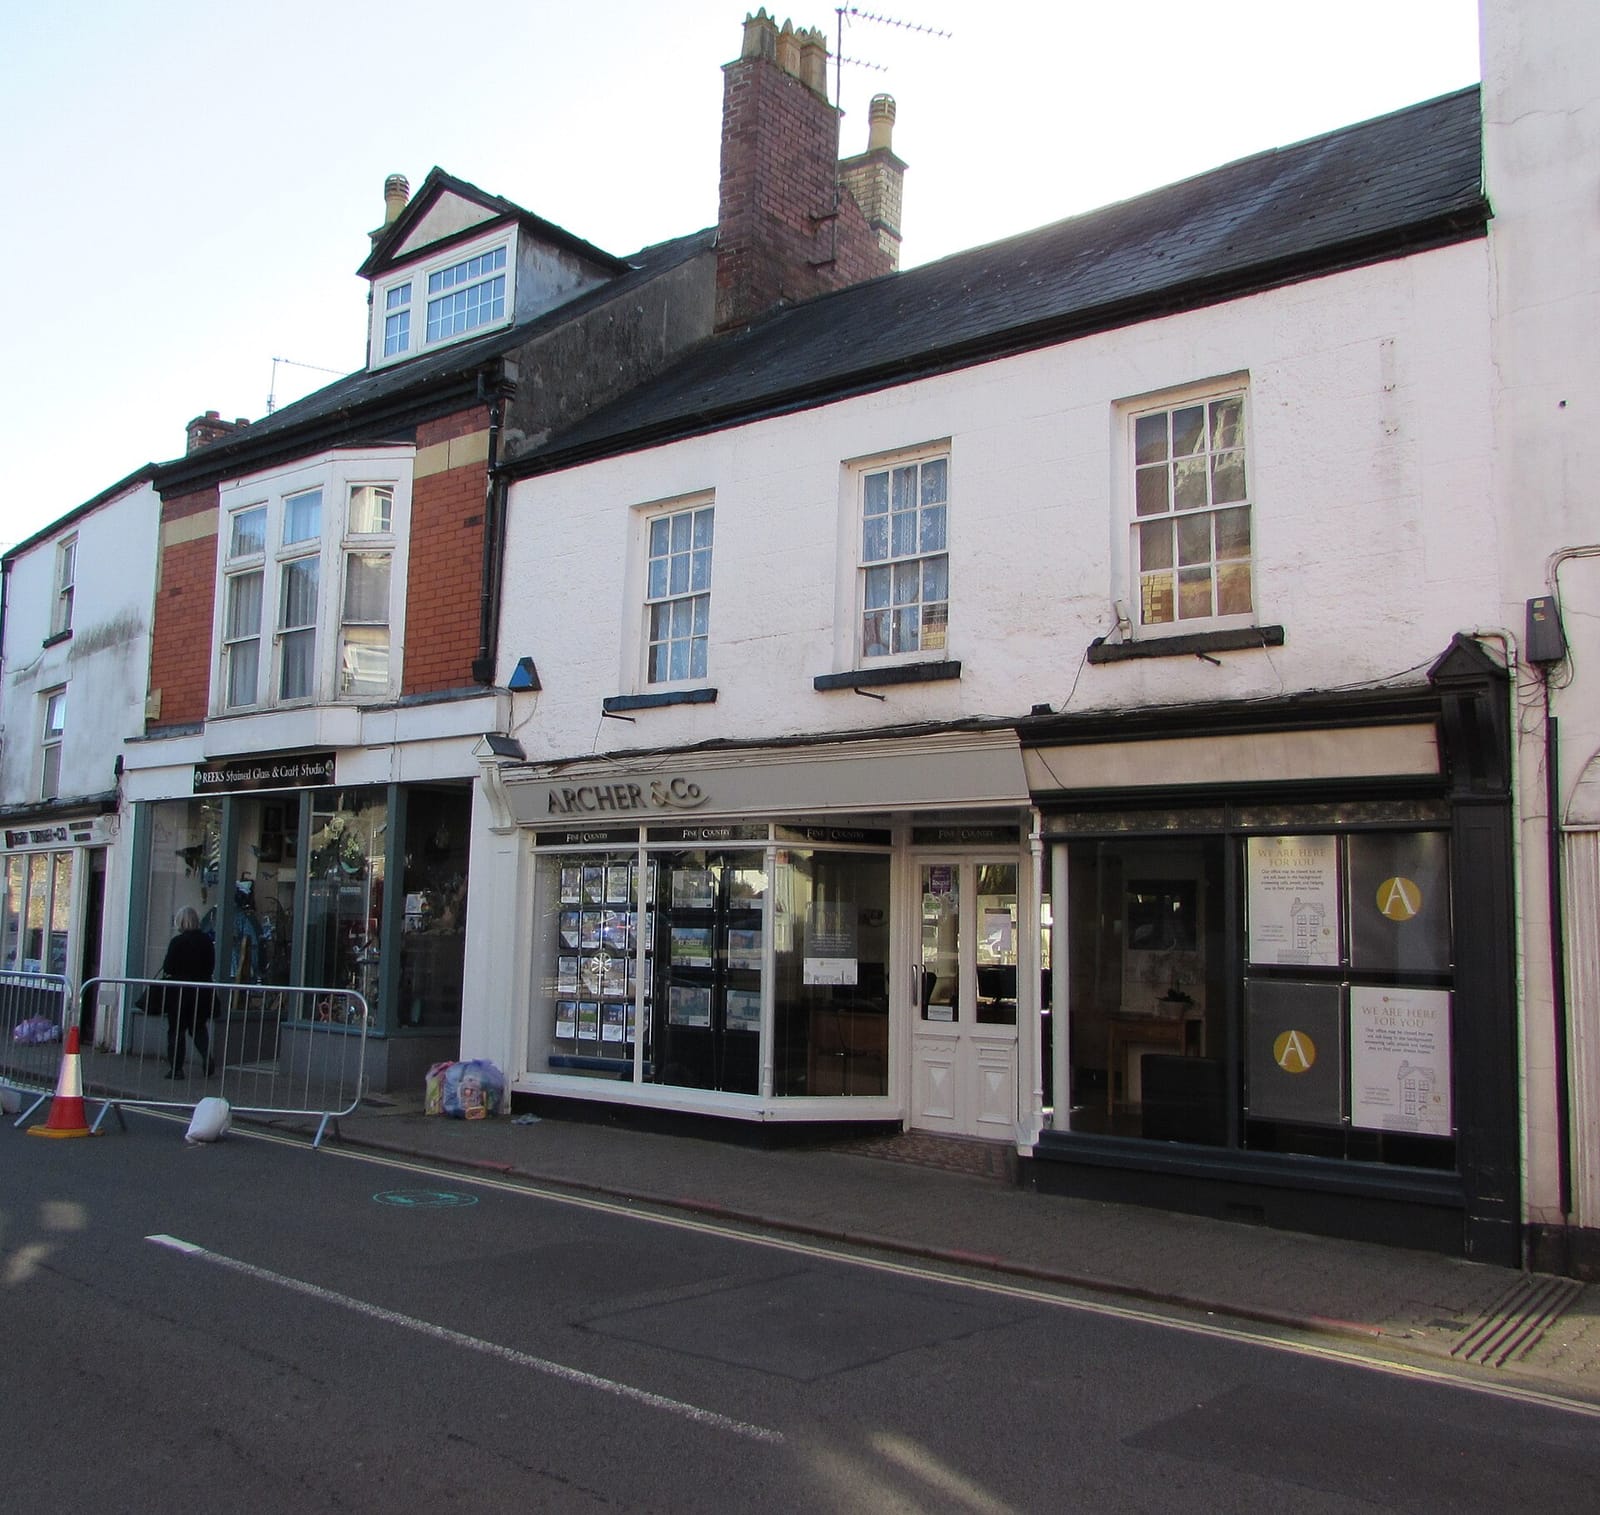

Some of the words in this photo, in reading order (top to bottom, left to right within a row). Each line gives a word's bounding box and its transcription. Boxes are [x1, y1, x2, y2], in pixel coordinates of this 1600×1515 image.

[202, 771, 224, 783] REEKS
[226, 768, 251, 782] Stained
[252, 767, 270, 779] Glass
[271, 766, 280, 778] &
[280, 764, 299, 778] Craft
[301, 763, 325, 776] Studio
[548, 783, 647, 813] ARCHER
[1299, 848, 1326, 857] HERE
[1382, 877, 1416, 914] A
[1361, 1007, 1378, 1016] WE
[1382, 1007, 1401, 1017] ARE
[1407, 1008, 1437, 1019] HERE
[1400, 1018, 1424, 1028] YOU
[1278, 1030, 1310, 1067] A
